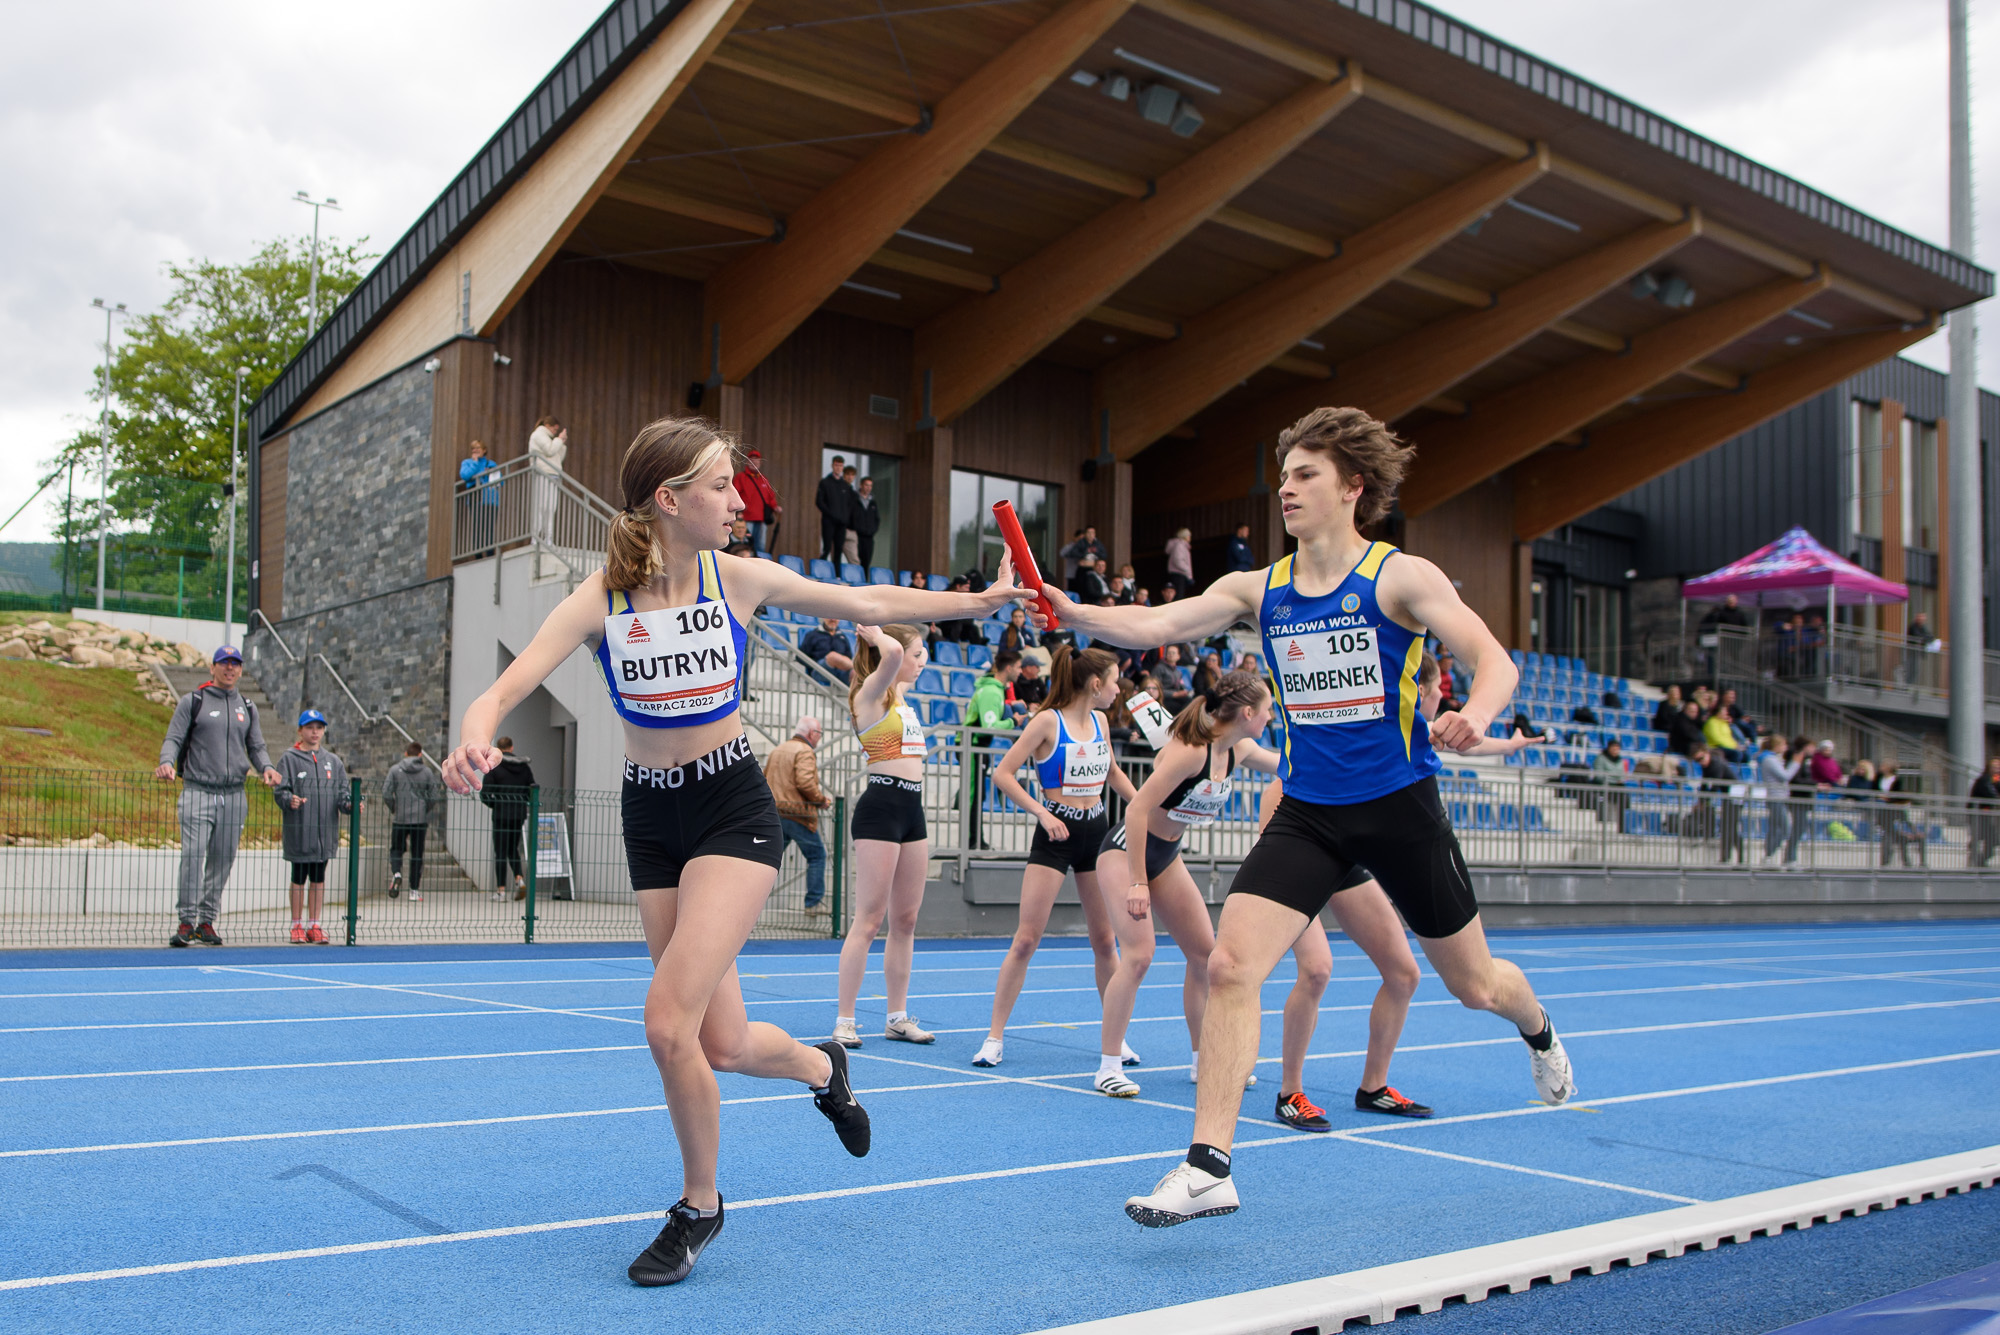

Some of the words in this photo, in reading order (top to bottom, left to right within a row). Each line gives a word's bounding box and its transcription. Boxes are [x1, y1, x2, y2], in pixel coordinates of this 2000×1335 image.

[675, 605, 724, 636] 106
[1269, 620, 1327, 636] STALOWA
[1329, 614, 1367, 628] WOLA
[626, 637, 651, 645] KARPACZ
[1326, 631, 1370, 656] 105
[621, 646, 728, 682] BUTRYN
[1283, 664, 1379, 693] BEMBENEK
[636, 700, 686, 712] KARPACZ
[689, 697, 714, 708] 2022
[1295, 710, 1335, 720] KARPACZ
[1336, 708, 1359, 718] 2022
[637, 766, 685, 789] PRO
[696, 733, 751, 781] NIKE
[1070, 762, 1107, 777] ŁAŃSKA
[897, 781, 922, 792] NIKE
[1055, 803, 1085, 820] PRO
[1208, 1147, 1230, 1166] PUMA
